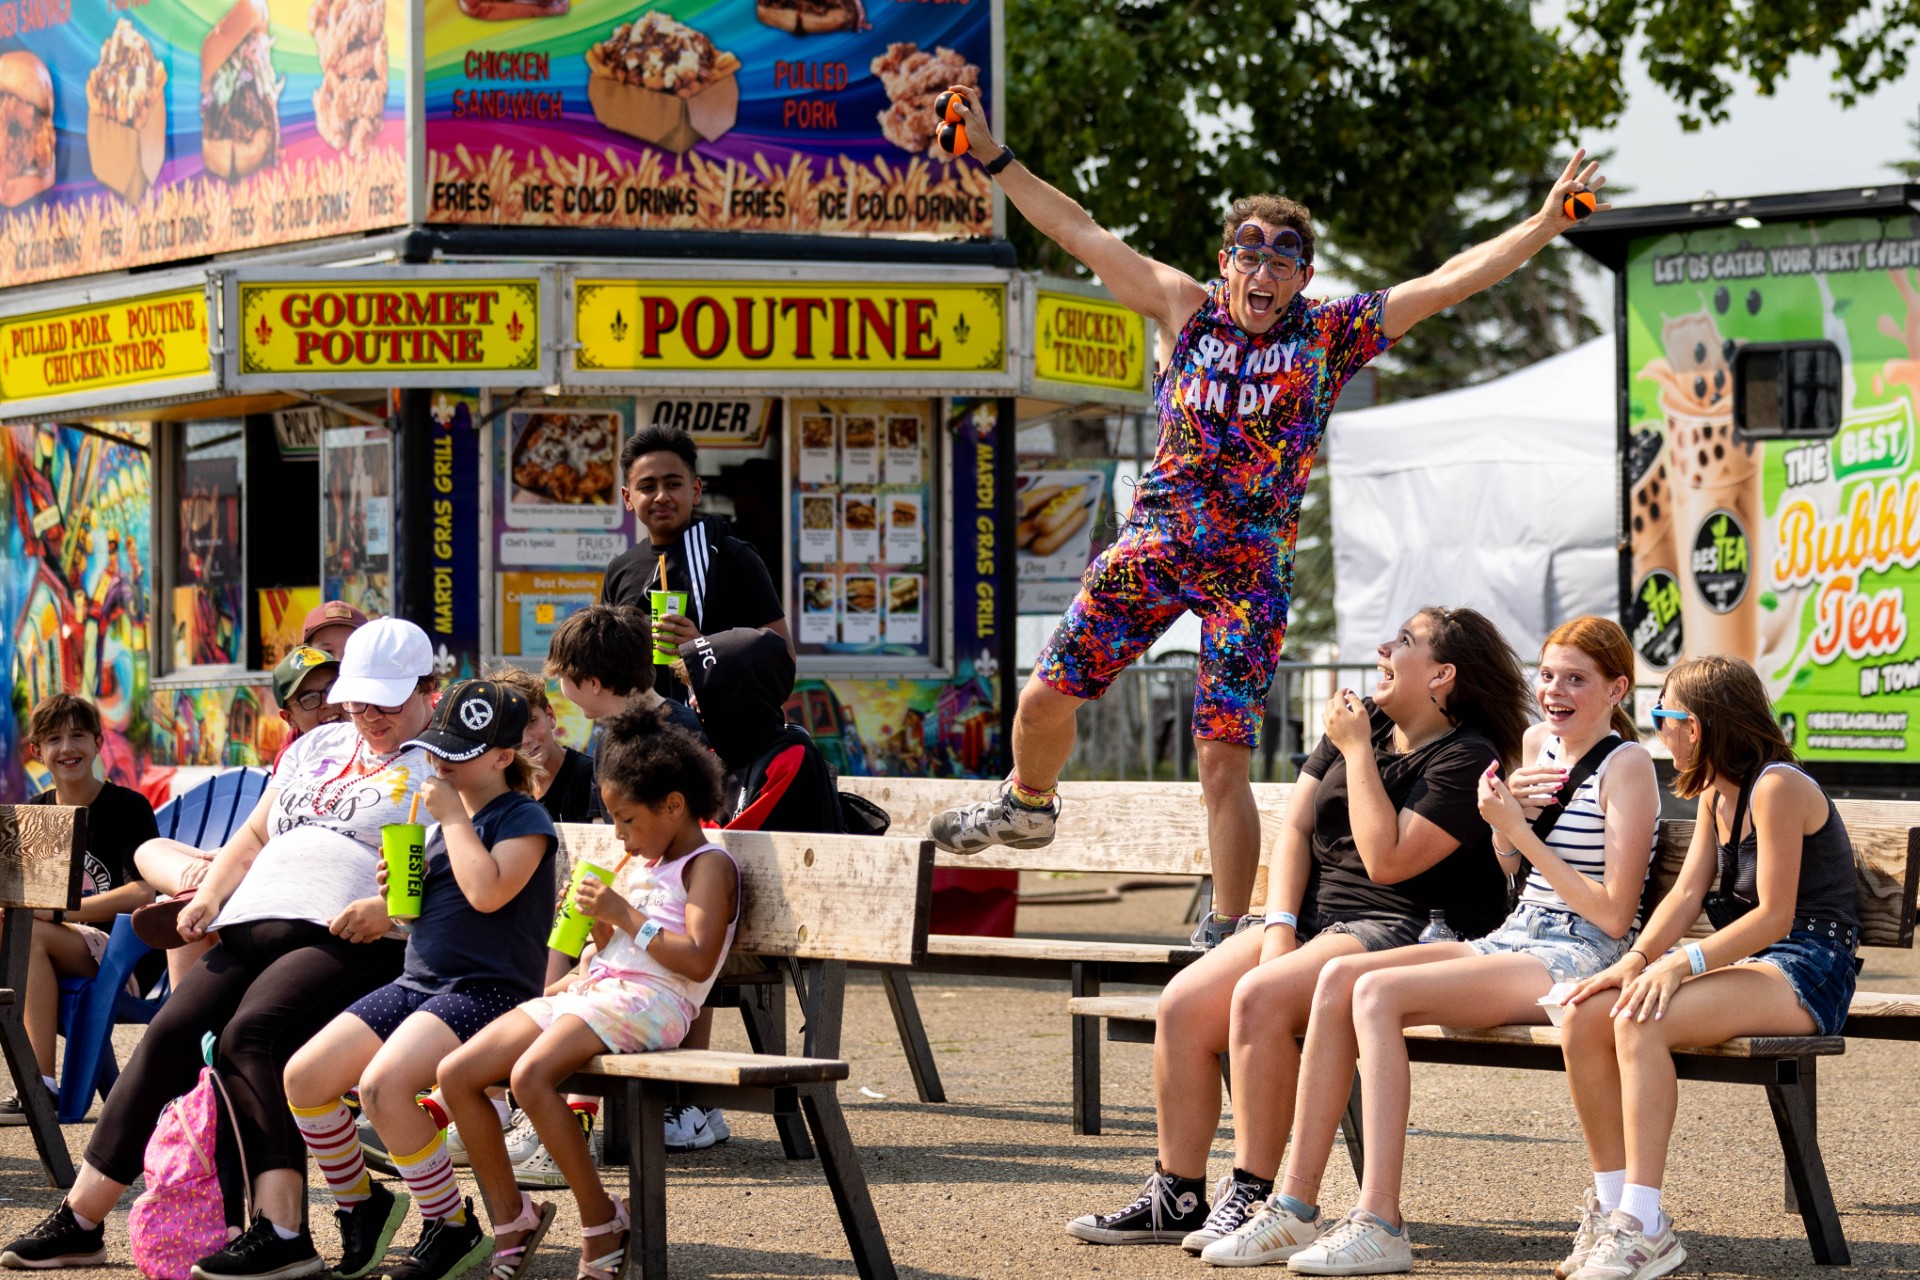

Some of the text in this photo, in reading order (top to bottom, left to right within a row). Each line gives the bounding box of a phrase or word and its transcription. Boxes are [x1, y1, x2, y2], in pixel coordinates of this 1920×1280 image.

[464, 50, 549, 81] CHICKEN
[774, 60, 849, 92] PULLED
[452, 89, 563, 120] SANDWICH
[783, 99, 838, 130] PORK
[368, 183, 395, 217] FRIES
[432, 182, 986, 224] FRIES ICE COLD DRINKS FRIES ICE COLD DRINKS
[1654, 238, 1920, 284] LET US CATER YOUR NEXT EVENT
[11, 300, 196, 358] PULLED PORK POUTINE
[280, 291, 499, 328] GOURMET
[640, 295, 942, 361] POUTINE
[1055, 306, 1126, 345] CHICKEN
[43, 338, 166, 387] CHICKEN STRIPS
[294, 329, 485, 366] POUTINE
[1053, 341, 1128, 380] TENDERS
[652, 400, 751, 432] ORDER
[1785, 422, 1903, 487] THE BEST
[434, 434, 453, 635] MARDI GRAS GRILL
[577, 537, 613, 550] FRIES
[976, 443, 994, 638] MARDI GRAS GRILL
[533, 577, 598, 589] Best Poutine
[1814, 576, 1901, 656] Tea
[1860, 667, 1879, 696] IN
[407, 844, 423, 897] BESTEA
